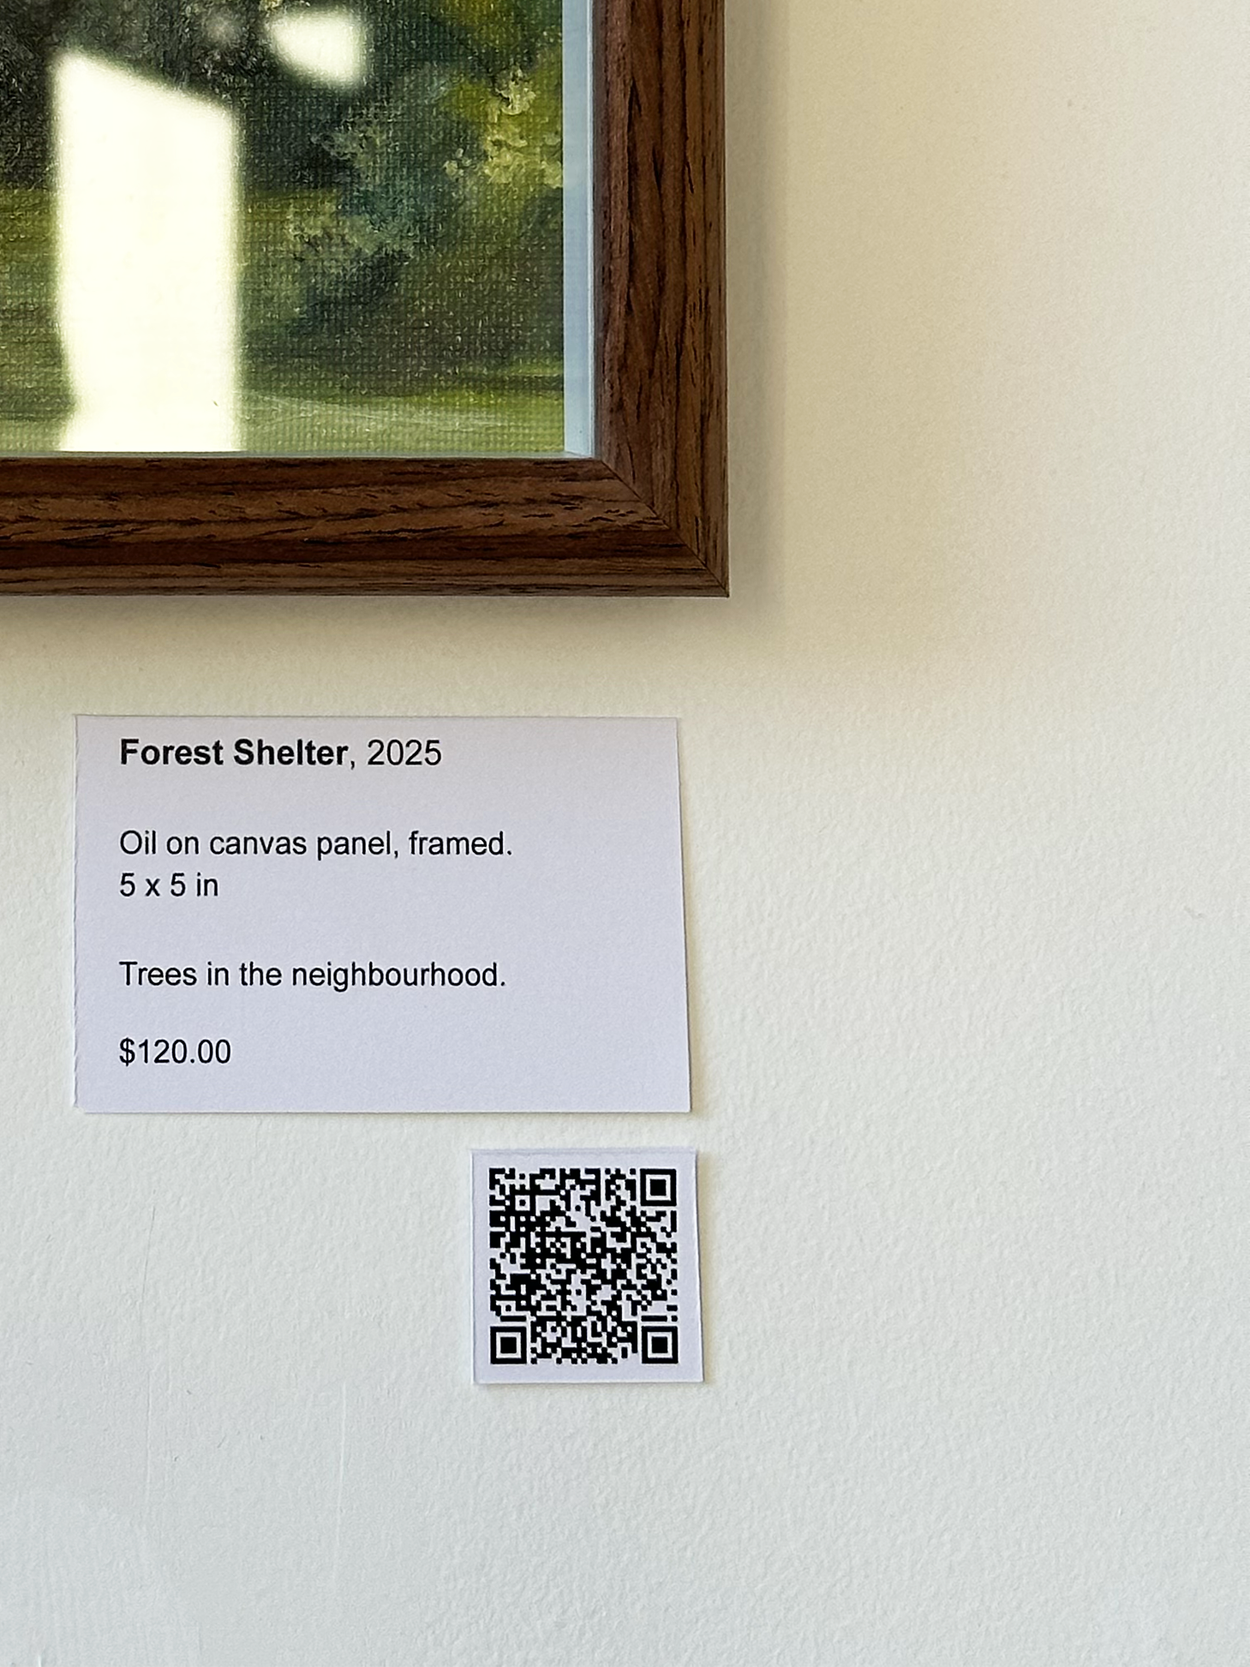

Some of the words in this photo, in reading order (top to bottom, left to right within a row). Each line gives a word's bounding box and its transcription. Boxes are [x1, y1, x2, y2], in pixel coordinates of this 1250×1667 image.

[121, 739, 224, 766] Forest
[234, 739, 355, 770] Shelter,
[368, 739, 442, 766] 2025
[120, 830, 157, 855] Oil
[166, 836, 199, 855] on
[209, 836, 307, 855] canvas
[317, 830, 399, 861] panel,
[409, 830, 512, 855] framed.
[120, 873, 136, 897] 5
[145, 879, 161, 897] x
[170, 873, 187, 897] 5
[196, 872, 219, 897] in
[119, 961, 197, 986] Trees
[207, 961, 230, 986] in
[239, 961, 283, 986] the
[292, 961, 506, 992] neighbourhood.
[119, 1037, 231, 1067] $120.00
